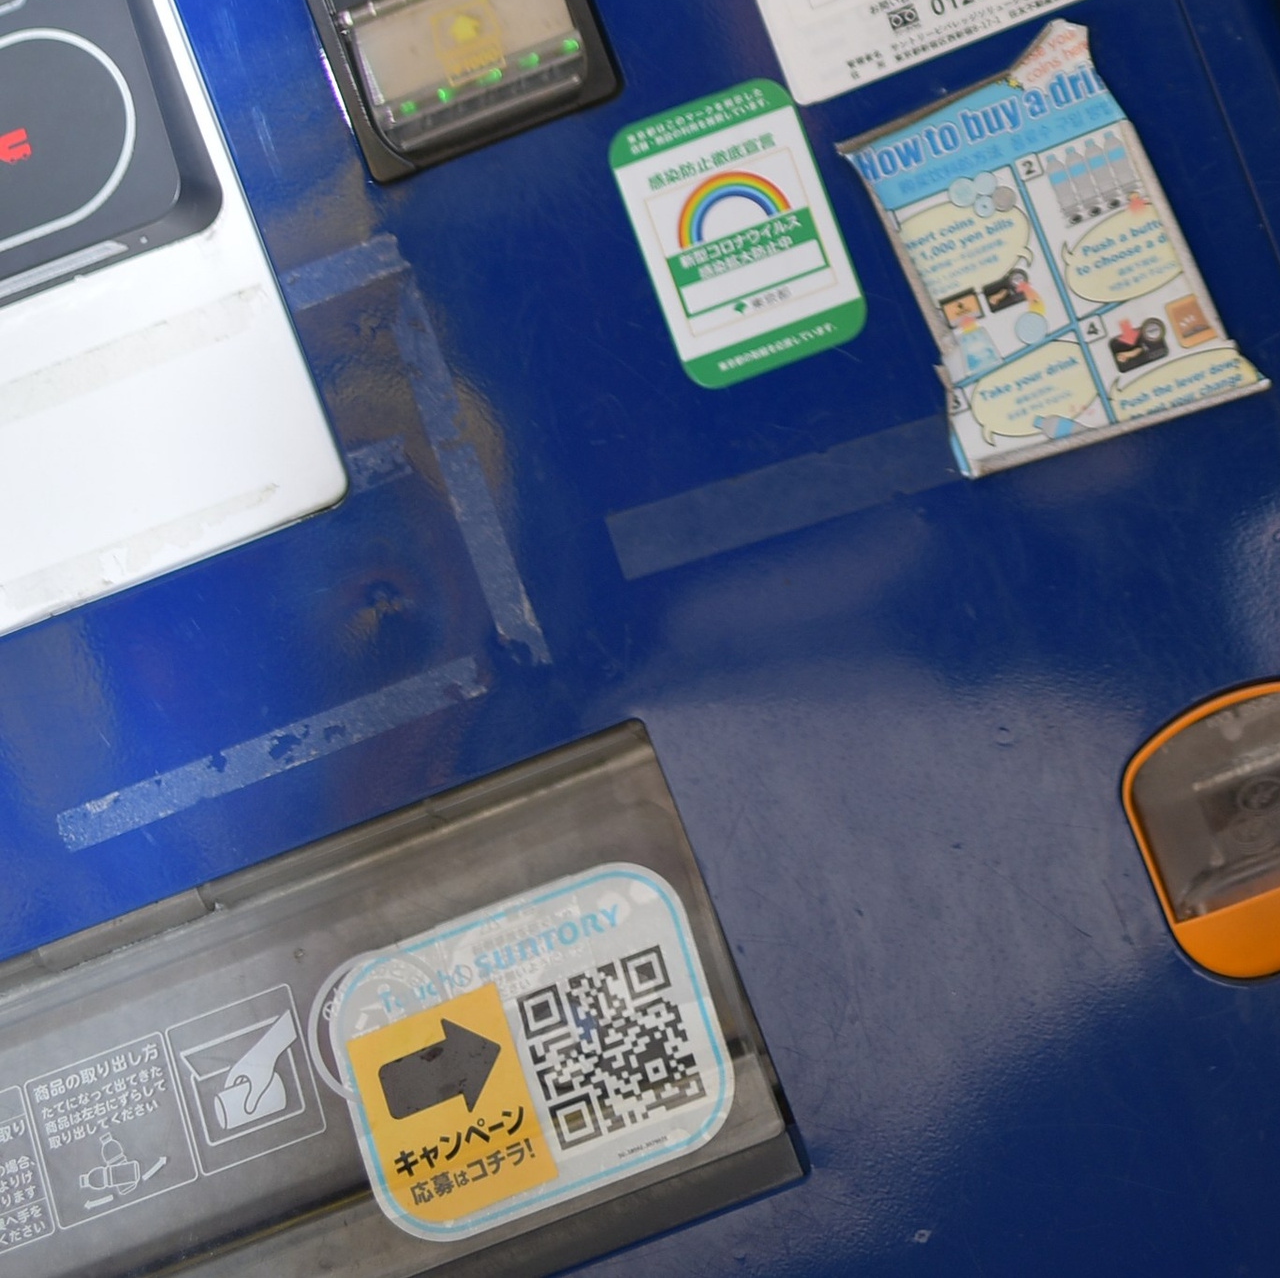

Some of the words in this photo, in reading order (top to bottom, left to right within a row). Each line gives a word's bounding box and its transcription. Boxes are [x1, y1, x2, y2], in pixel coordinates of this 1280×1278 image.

[646, 131, 776, 191] 感染防止徹底宣言
[855, 132, 927, 185] How
[922, 119, 962, 159] to
[959, 95, 1023, 143] buy
[1022, 86, 1048, 119] a
[1021, 158, 1035, 176] 2
[677, 213, 802, 270] 新型コロナウイルス
[937, 215, 974, 238] coins
[958, 229, 983, 248] yen
[984, 214, 1014, 236] bills
[1081, 235, 1115, 256] Push
[1118, 232, 1127, 242] a
[697, 233, 794, 279] 感染拡大防止中
[1075, 263, 1090, 276] to
[1092, 242, 1142, 269] choose
[1144, 238, 1154, 249] a
[1084, 319, 1099, 337] 4
[978, 379, 1013, 403] Take
[1014, 369, 1044, 392] your
[1045, 352, 1079, 377] drink
[1119, 390, 1149, 410] Push
[1152, 381, 1172, 397] the
[1174, 369, 1205, 388] lever
[1198, 372, 1243, 396] change
[471, 903, 618, 979] SUNTORY
[32, 1041, 160, 1103] 商品の取り出し方
[40, 1064, 164, 1120] たてになって出てきた
[43, 1079, 168, 1135] 商品は左右にずらして
[47, 1098, 159, 1150] 取り出してください
[391, 1104, 531, 1181] キャンペーン
[409, 1137, 537, 1207] 応募はコチラ!
